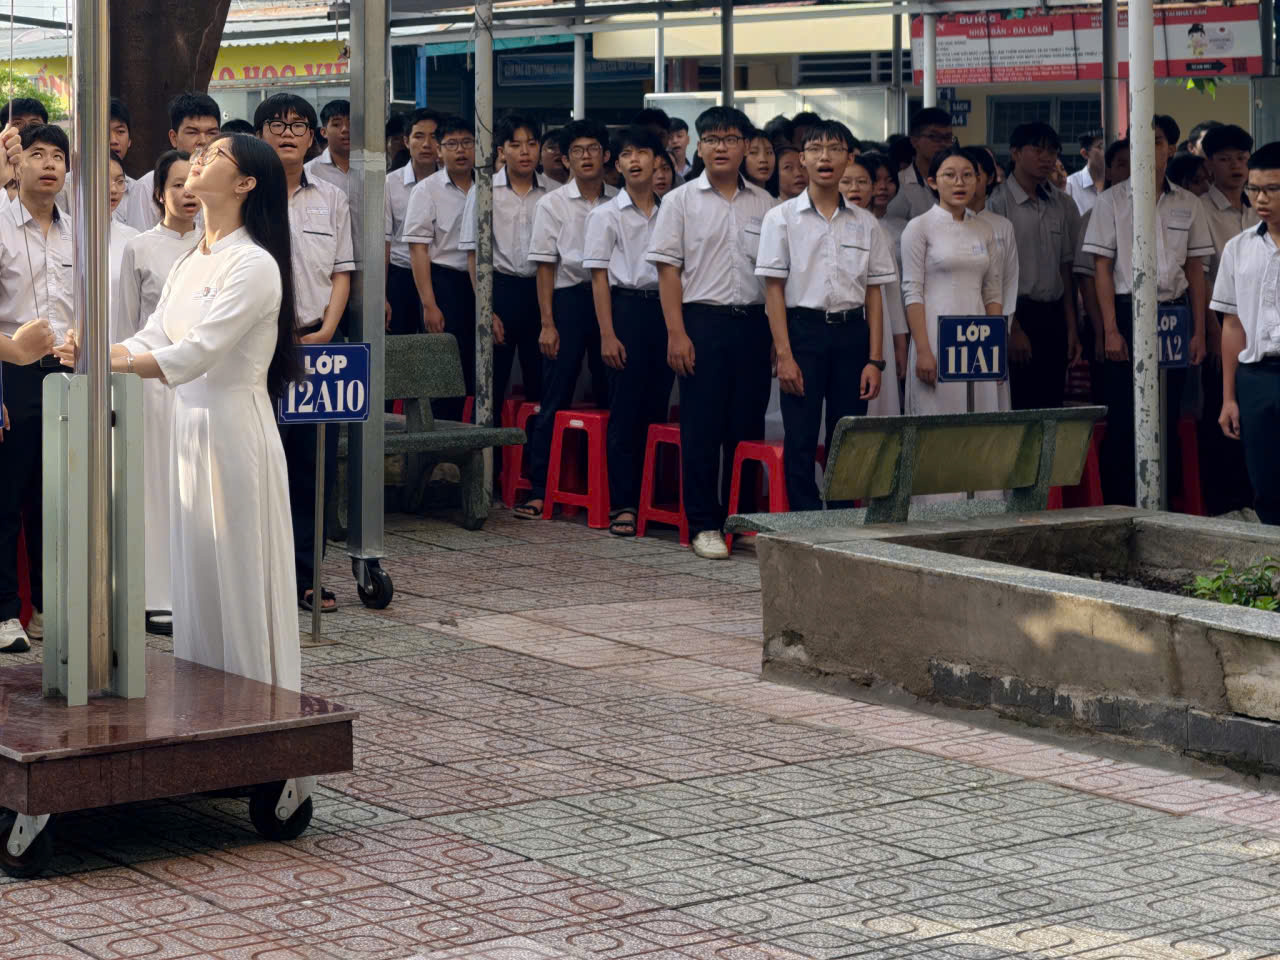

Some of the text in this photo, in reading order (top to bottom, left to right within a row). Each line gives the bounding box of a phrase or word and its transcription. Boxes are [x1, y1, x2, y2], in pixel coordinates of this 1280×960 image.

[956, 321, 991, 342] LỚP
[304, 351, 348, 375] LỚP
[945, 345, 1001, 375] 11A1
[285, 379, 365, 414] 12A10
